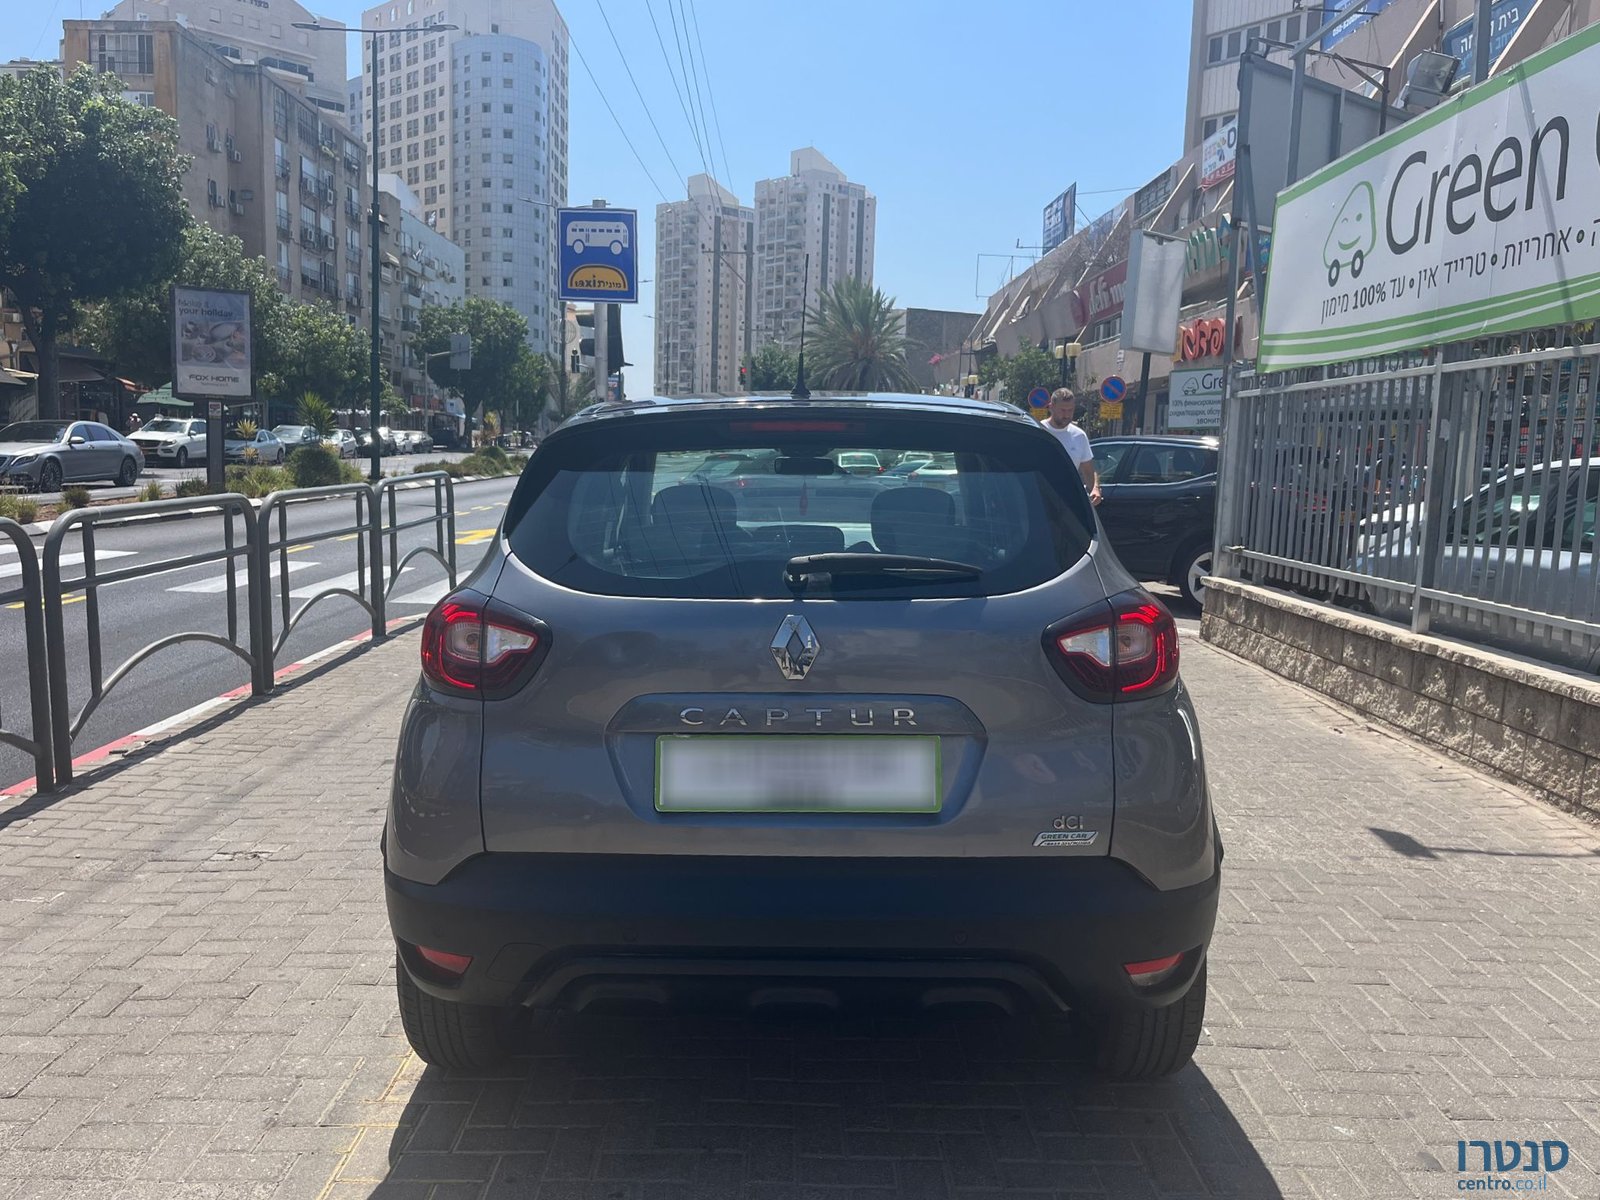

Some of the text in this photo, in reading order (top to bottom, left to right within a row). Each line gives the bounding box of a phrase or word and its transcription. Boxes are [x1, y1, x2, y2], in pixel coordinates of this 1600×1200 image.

[1498, 8, 1519, 31] בית
[1386, 116, 1570, 256] Green
[1502, 227, 1572, 270] אחריות
[1443, 253, 1486, 283] טרייד
[575, 275, 622, 289] taxi מונית
[1353, 281, 1387, 309] 100%
[1390, 275, 1407, 300] עד
[1416, 265, 1439, 299] אין
[179, 307, 233, 318] your holiday
[1321, 291, 1349, 325] מימון
[211, 375, 240, 383] HOME
[680, 708, 917, 726] CAPTUR
